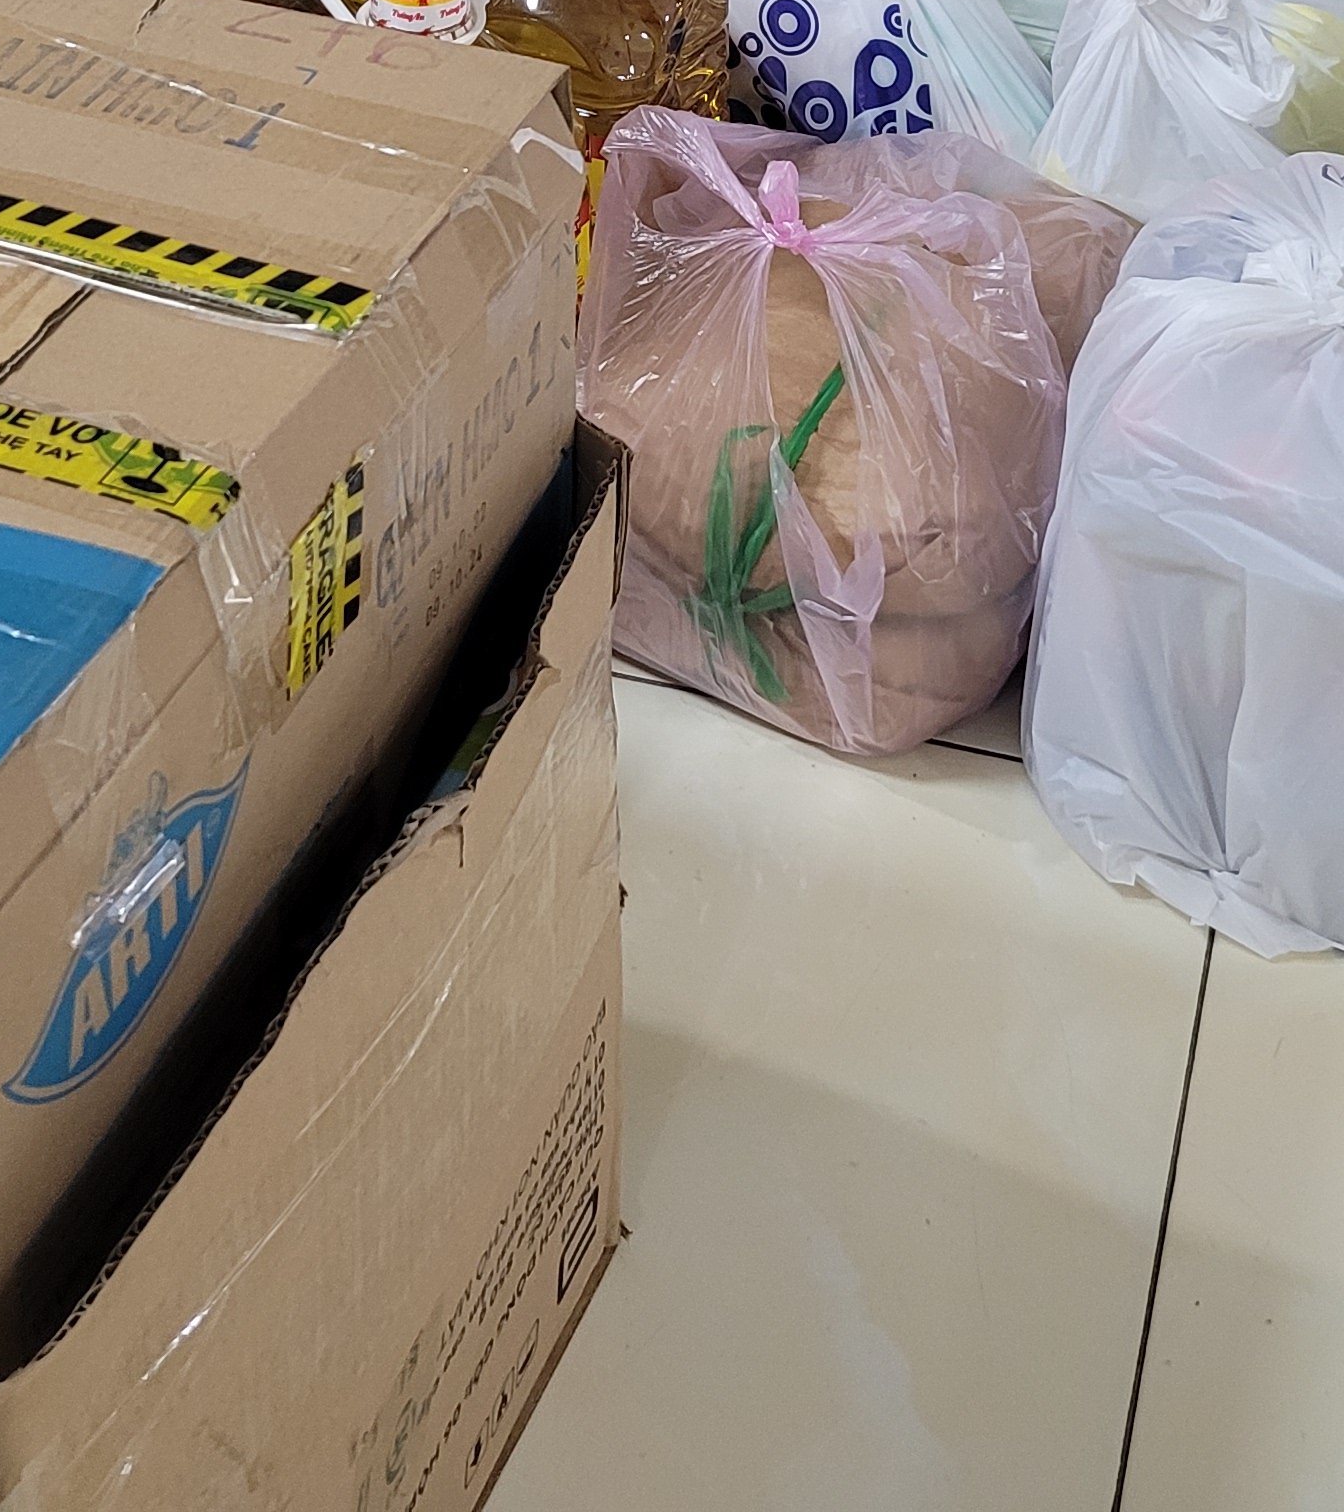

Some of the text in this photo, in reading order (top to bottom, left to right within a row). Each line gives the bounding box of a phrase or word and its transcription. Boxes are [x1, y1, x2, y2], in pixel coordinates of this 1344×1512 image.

[223, 101, 286, 152] 1
[31, 437, 85, 464] TAY
[577, 1125, 604, 1184] QUY
[540, 1179, 575, 1256] CÁCH
[443, 1402, 462, 1444] 06
